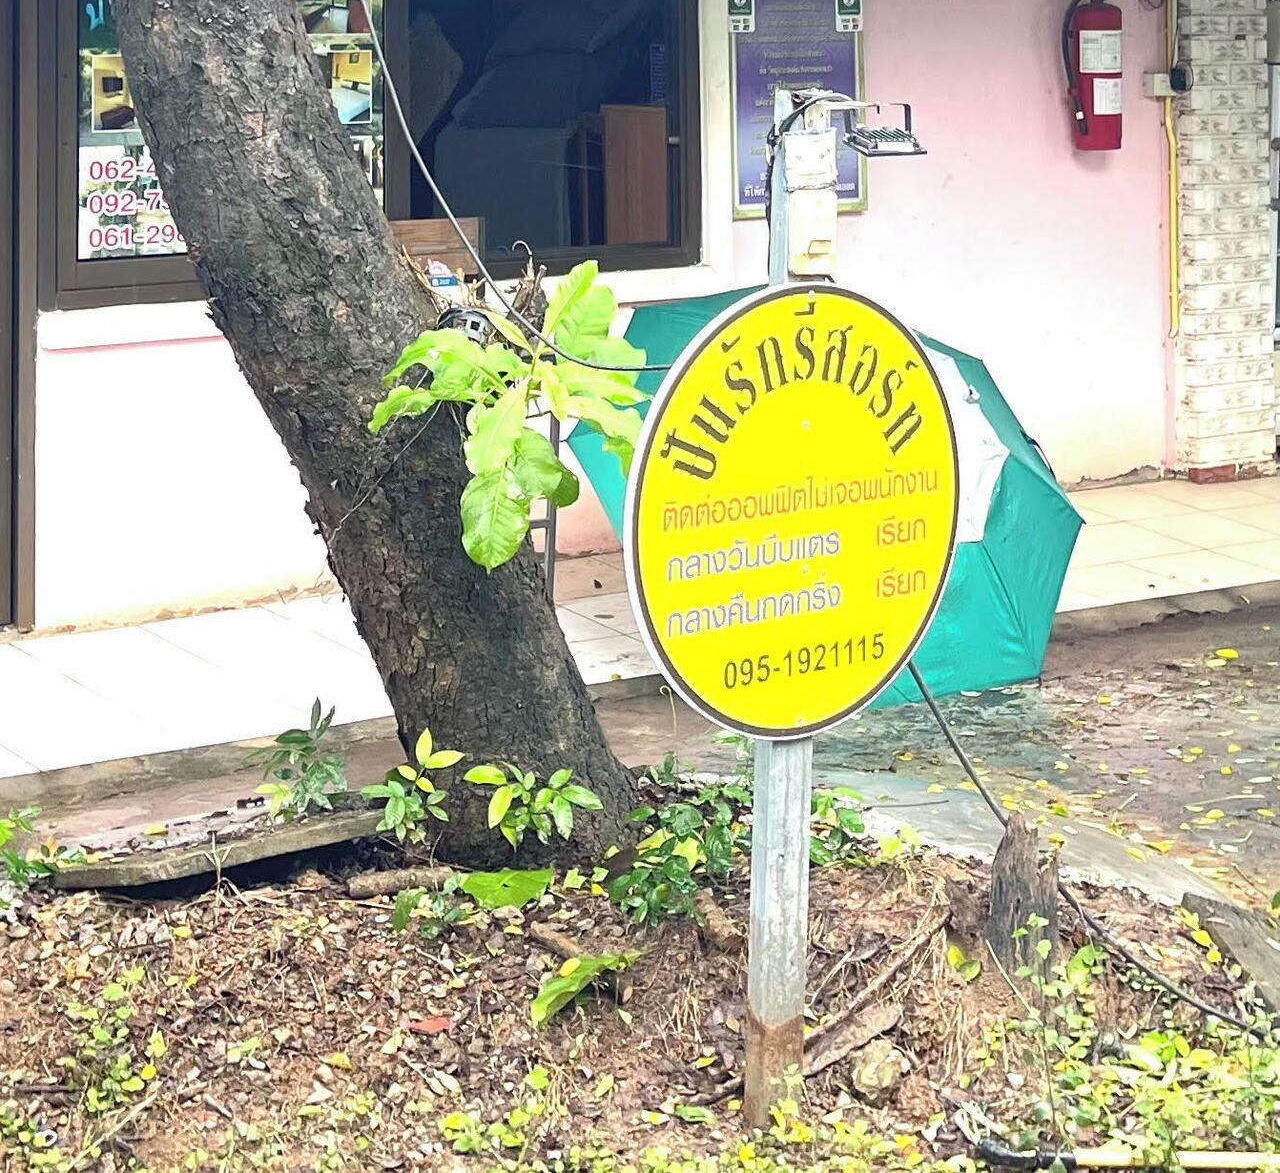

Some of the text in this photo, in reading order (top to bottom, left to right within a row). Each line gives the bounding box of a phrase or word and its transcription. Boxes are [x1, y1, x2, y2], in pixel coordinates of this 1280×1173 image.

[89, 192, 169, 214] 092-7
[668, 515, 926, 582] กลางวันบีบแตร เรียก
[668, 567, 926, 638] กลางคืนกดกริ่ง เรียก
[724, 633, 885, 689] 095-1921115
